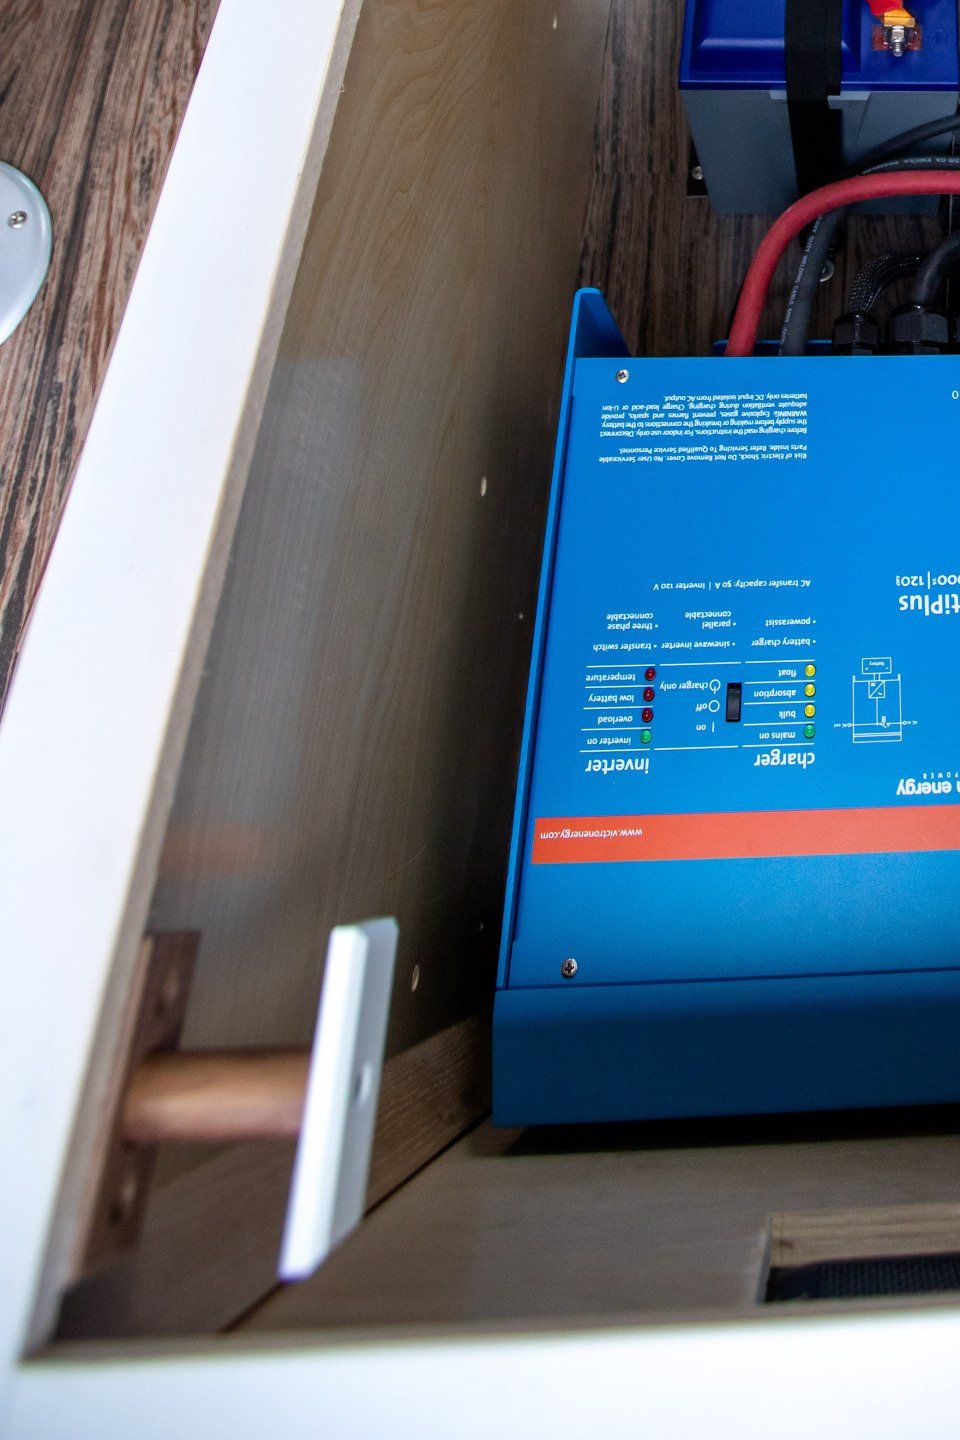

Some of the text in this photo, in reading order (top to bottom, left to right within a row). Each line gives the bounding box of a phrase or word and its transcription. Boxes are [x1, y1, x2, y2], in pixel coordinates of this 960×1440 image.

[678, 445, 708, 453] Qualified
[719, 444, 749, 452] Servicing
[675, 582, 705, 590] Inverter
[715, 582, 721, 590] A
[722, 579, 732, 588] 50
[733, 579, 767, 589] capacity:
[769, 580, 799, 588] transfer
[800, 579, 811, 587] AC
[606, 612, 654, 621] connectable
[684, 610, 732, 620] connectable
[607, 621, 654, 631] three phase
[701, 619, 731, 629] parallel
[765, 617, 811, 628] powerassist
[592, 642, 652, 652] transfer switch
[661, 640, 731, 650] sinewave inverter
[751, 637, 811, 648] battery charger
[585, 673, 636, 682] temperature
[778, 669, 797, 677] float
[659, 680, 709, 691] charger only
[588, 693, 634, 703] low battery
[754, 688, 797, 699] absorption
[695, 703, 707, 711] off
[778, 710, 796, 719] bulk
[597, 716, 633, 724] overload
[696, 724, 707, 732] on
[759, 731, 796, 740] mains on
[599, 737, 631, 746] inverter
[754, 749, 815, 769] charger
[585, 758, 650, 775] inverter
[922, 771, 958, 779] POWER
[896, 778, 951, 796] energy
[540, 828, 643, 840] www.victronenergy.com
